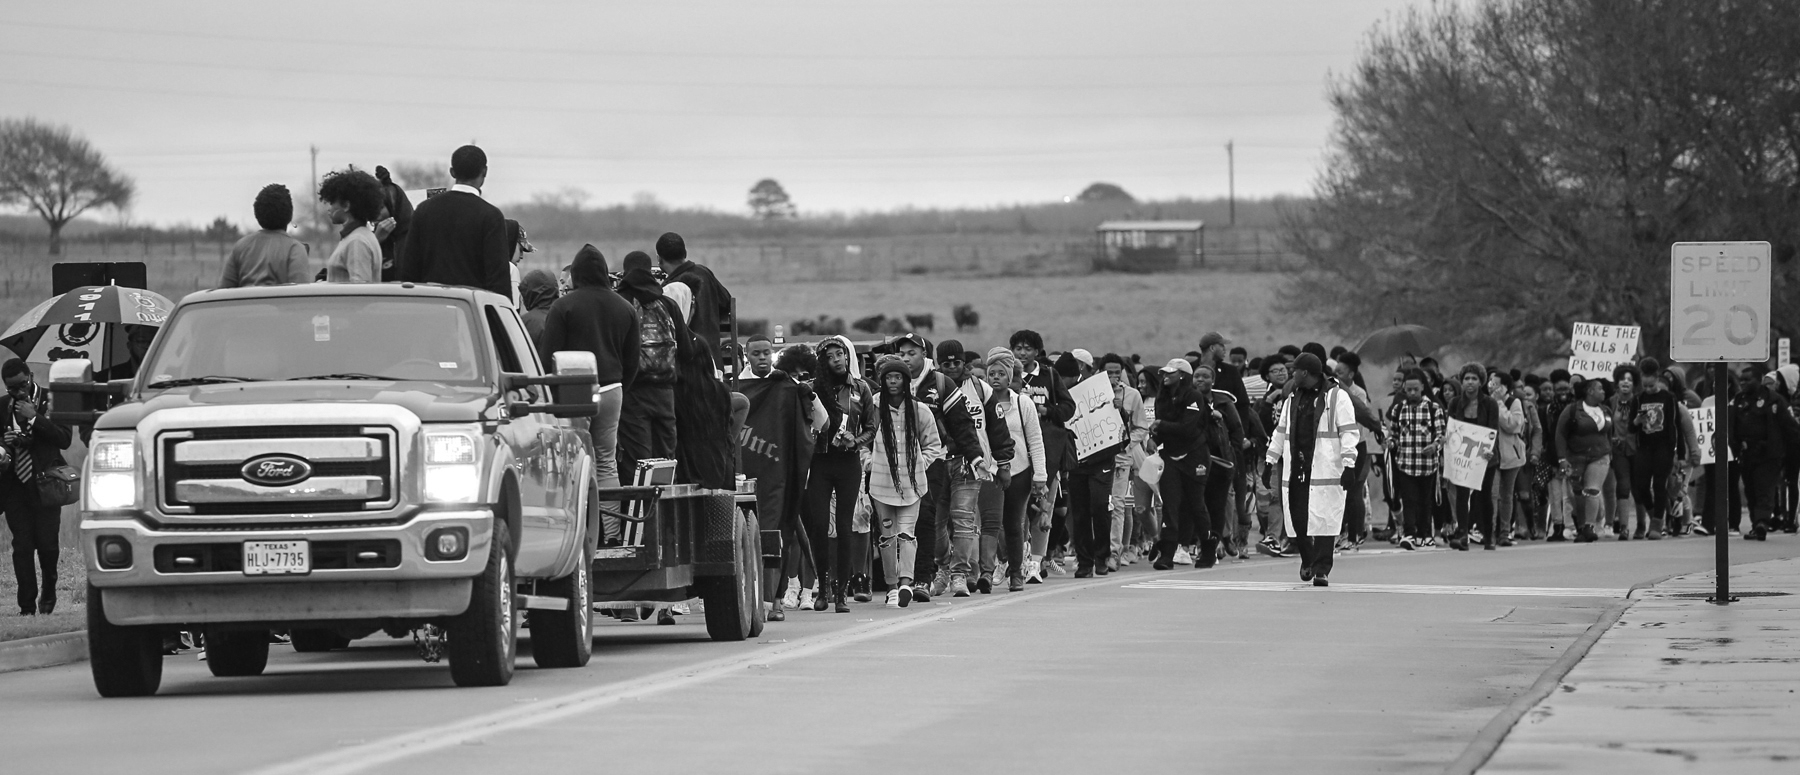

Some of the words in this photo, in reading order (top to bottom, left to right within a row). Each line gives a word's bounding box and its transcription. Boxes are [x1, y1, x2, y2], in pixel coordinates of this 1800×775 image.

[1681, 256, 1761, 273] SPEED
[1690, 280, 1751, 297] LIMIT
[74, 287, 104, 321] 1911
[1575, 324, 1610, 338] MAKE
[1616, 327, 1638, 339] THE
[1681, 304, 1759, 346] 20
[1574, 339, 1617, 354] POLLS
[1623, 343, 1630, 354] A
[1082, 388, 1108, 410] Vote
[1448, 432, 1491, 459] OTE
[257, 461, 295, 477] Ford
